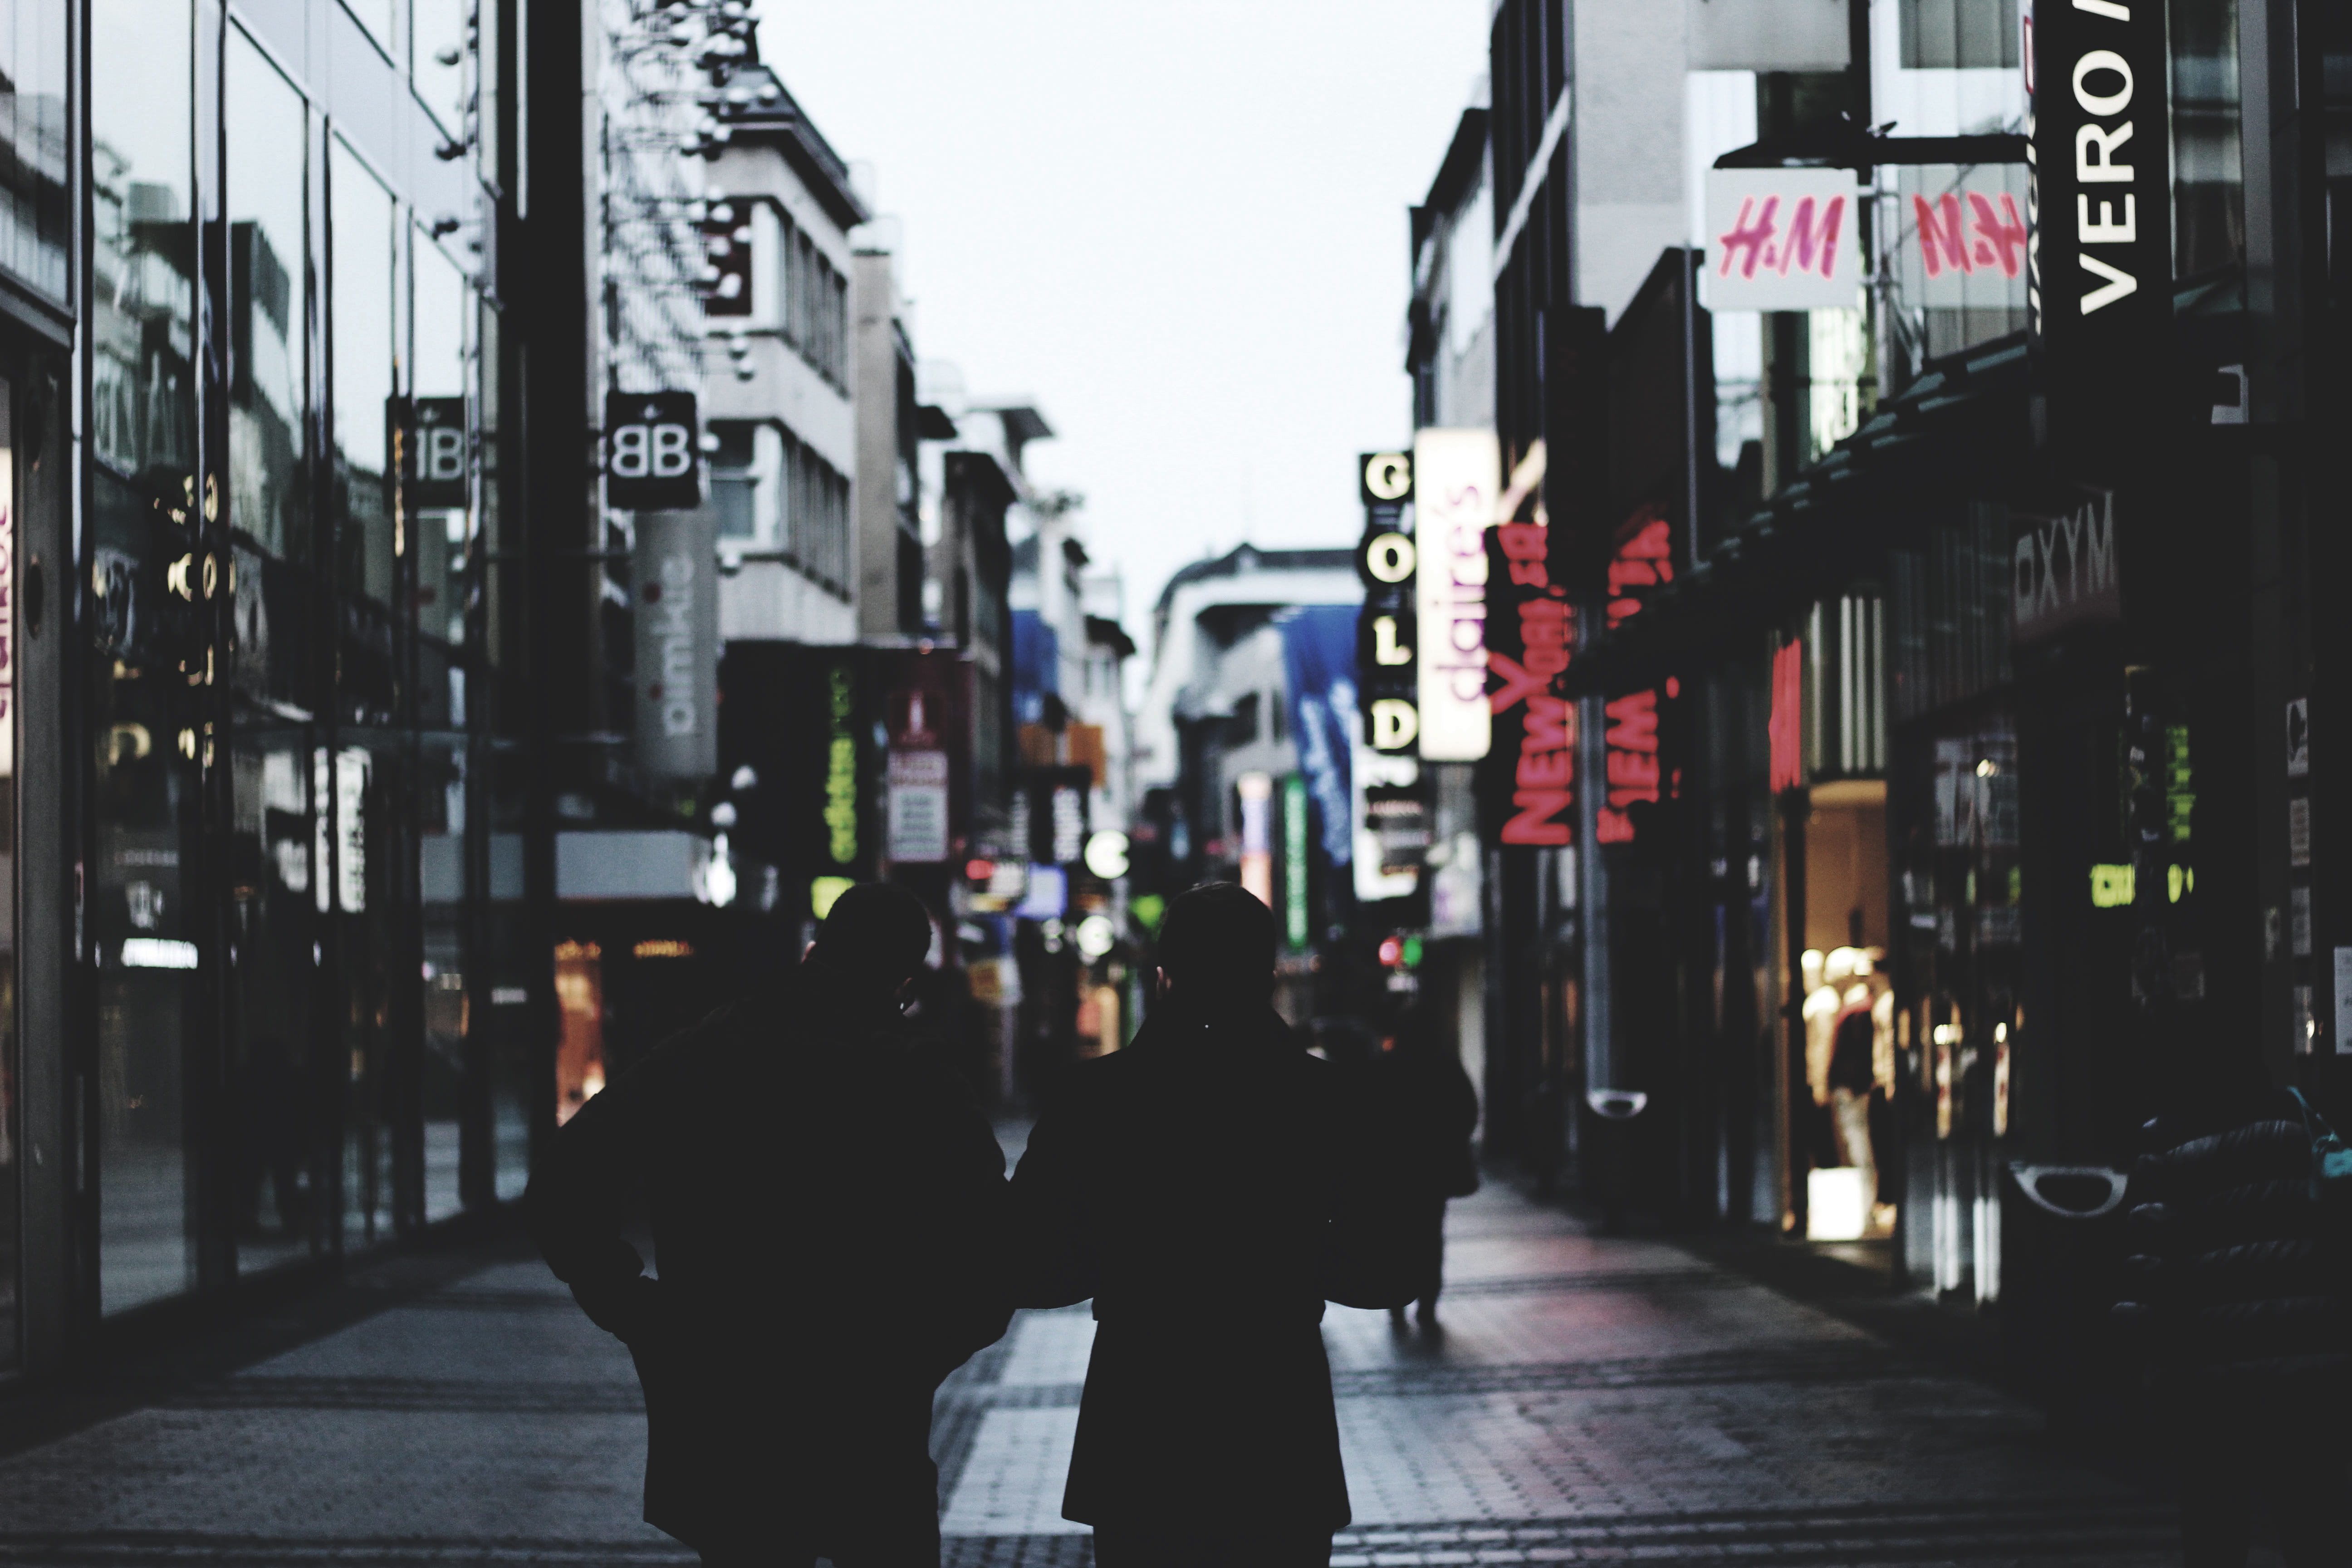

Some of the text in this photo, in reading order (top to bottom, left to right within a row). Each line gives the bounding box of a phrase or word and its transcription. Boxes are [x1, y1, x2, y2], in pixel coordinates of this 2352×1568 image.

[1720, 193, 1846, 279] H&M
[2072, 50, 2137, 315] VERO
[1366, 452, 1419, 750] GOLD
